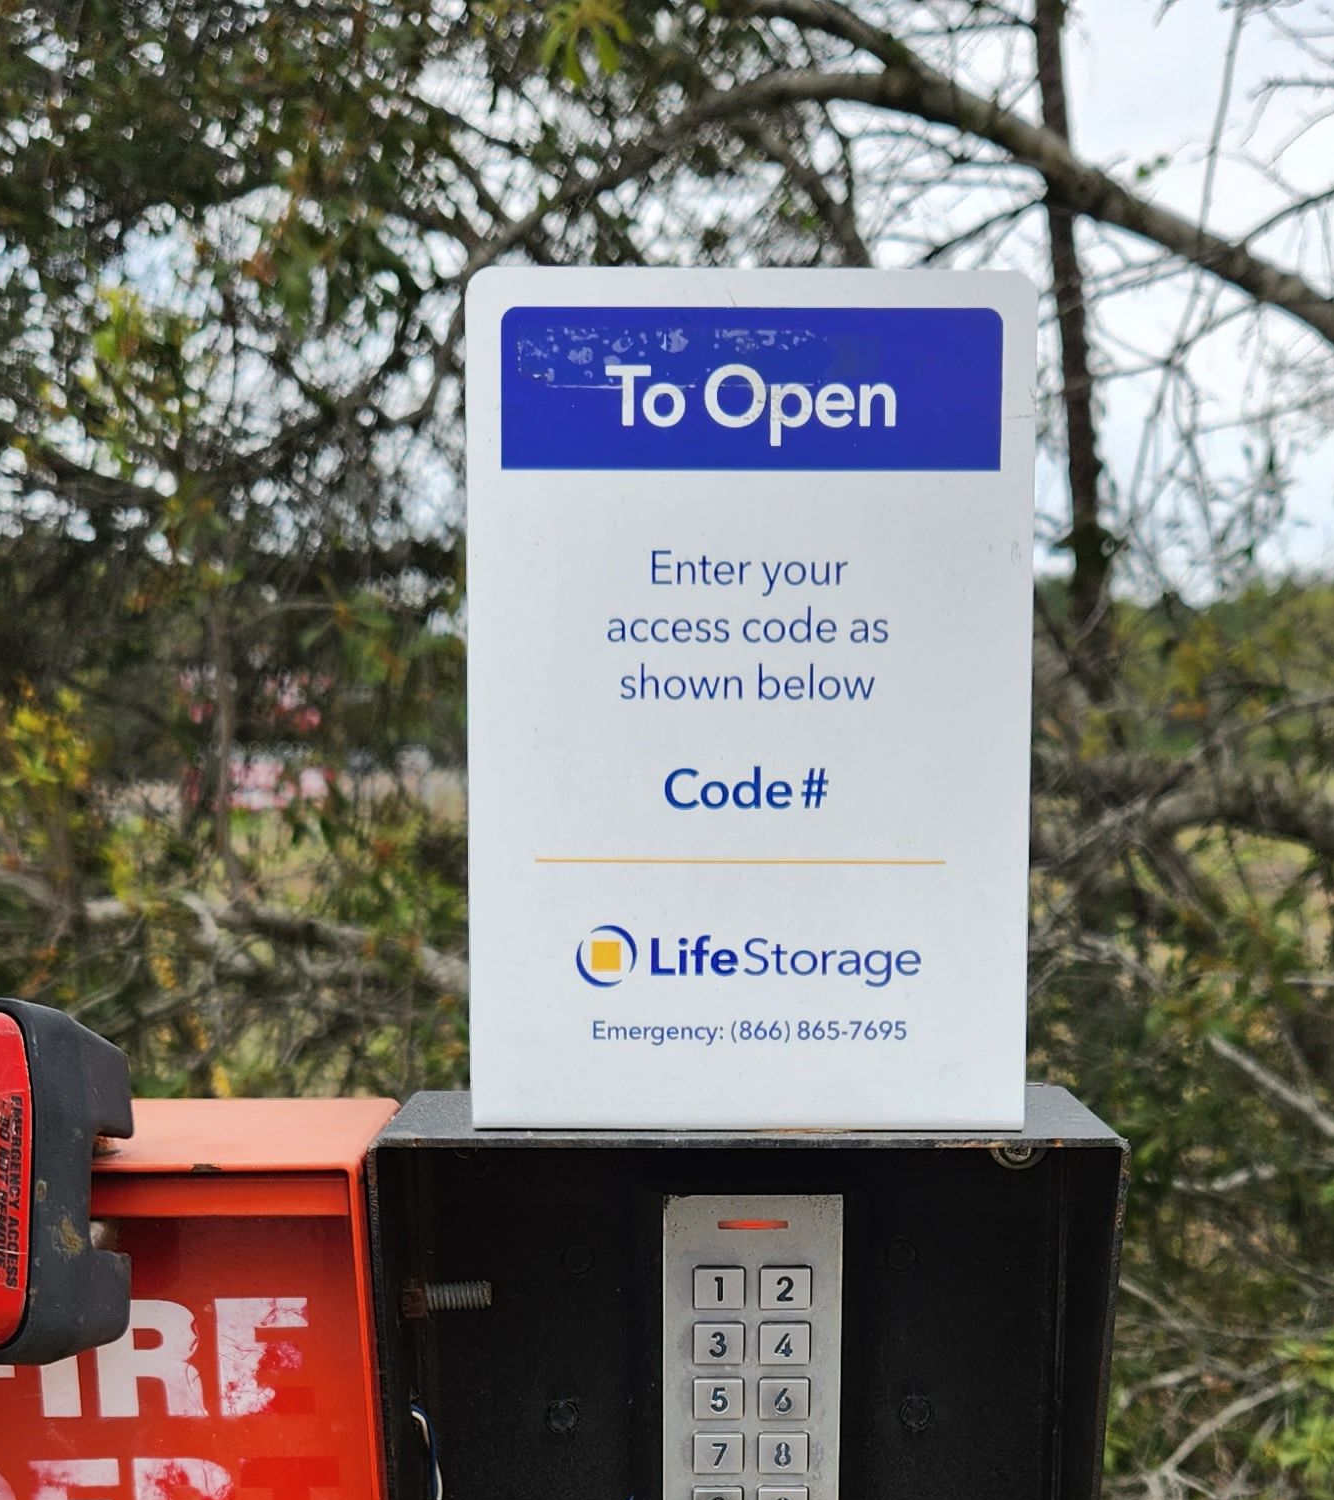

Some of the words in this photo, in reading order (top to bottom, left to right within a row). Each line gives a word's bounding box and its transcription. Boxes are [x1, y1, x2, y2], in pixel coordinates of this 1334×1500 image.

[605, 364, 686, 427] To
[703, 363, 898, 447] Open
[650, 550, 752, 586] Enter
[761, 557, 849, 597] your
[606, 617, 730, 644] access
[742, 606, 838, 644] code
[849, 617, 890, 644] as
[619, 663, 744, 702] shown
[757, 663, 876, 702] below
[591, 1020, 725, 1046] Emergency:
[729, 1020, 792, 1044] (866)
[796, 1020, 908, 1042] 865-7695
[9, 1095, 22, 1210] EMERGENCY
[6, 1216, 20, 1288] ACCESS
[714, 1276, 724, 1302] 1
[776, 1276, 795, 1302] 2
[709, 1331, 728, 1358] 3
[774, 1333, 793, 1358] 4
[710, 1387, 729, 1413] 5
[774, 1387, 793, 1413] 6
[711, 1443, 728, 1467] 7
[774, 1442, 792, 1468] 8
